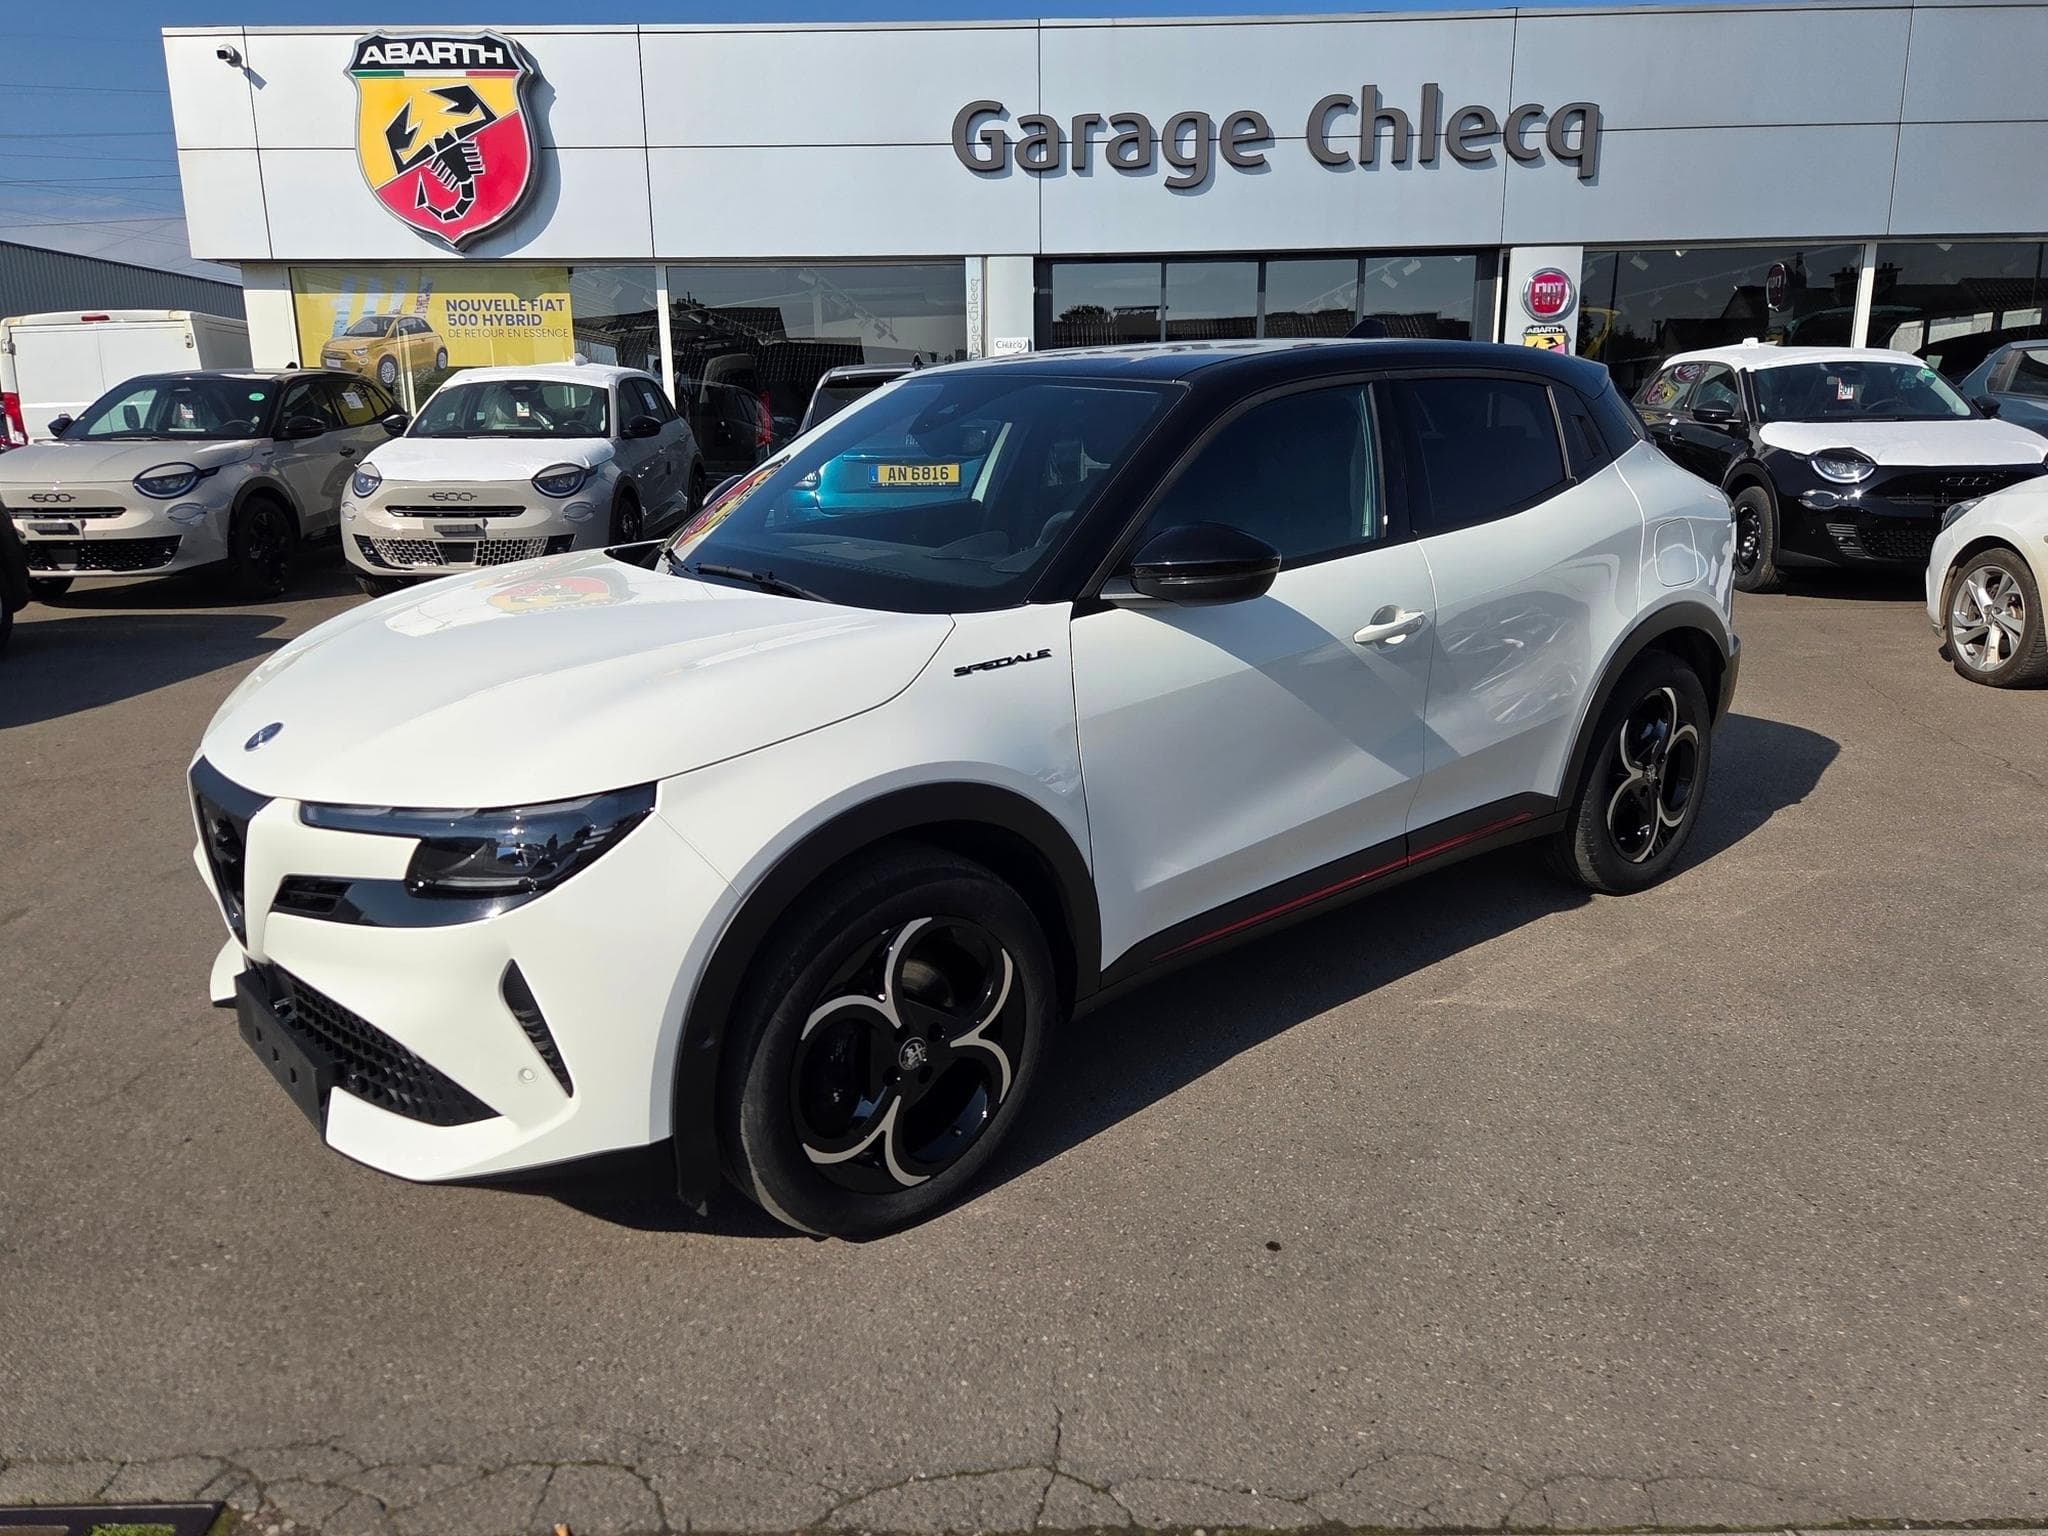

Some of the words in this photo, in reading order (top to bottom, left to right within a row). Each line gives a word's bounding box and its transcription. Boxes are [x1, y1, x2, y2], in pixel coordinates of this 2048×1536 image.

[360, 41, 504, 65] ABARTH
[951, 99, 1270, 189] Garage
[1306, 82, 1600, 180] Chlecq
[446, 299, 526, 312] NOUVELLE
[530, 298, 565, 312] FIAT
[448, 313, 478, 327] 500
[482, 313, 543, 327] HYBRID
[448, 328, 461, 338] DE
[464, 328, 505, 338] RETOUR
[507, 328, 521, 338] EN
[523, 328, 569, 338] ESSENCE
[887, 467, 907, 481] AN
[911, 466, 949, 481] 6816
[29, 493, 75, 503] 600
[953, 648, 1053, 678] SPECIALE
